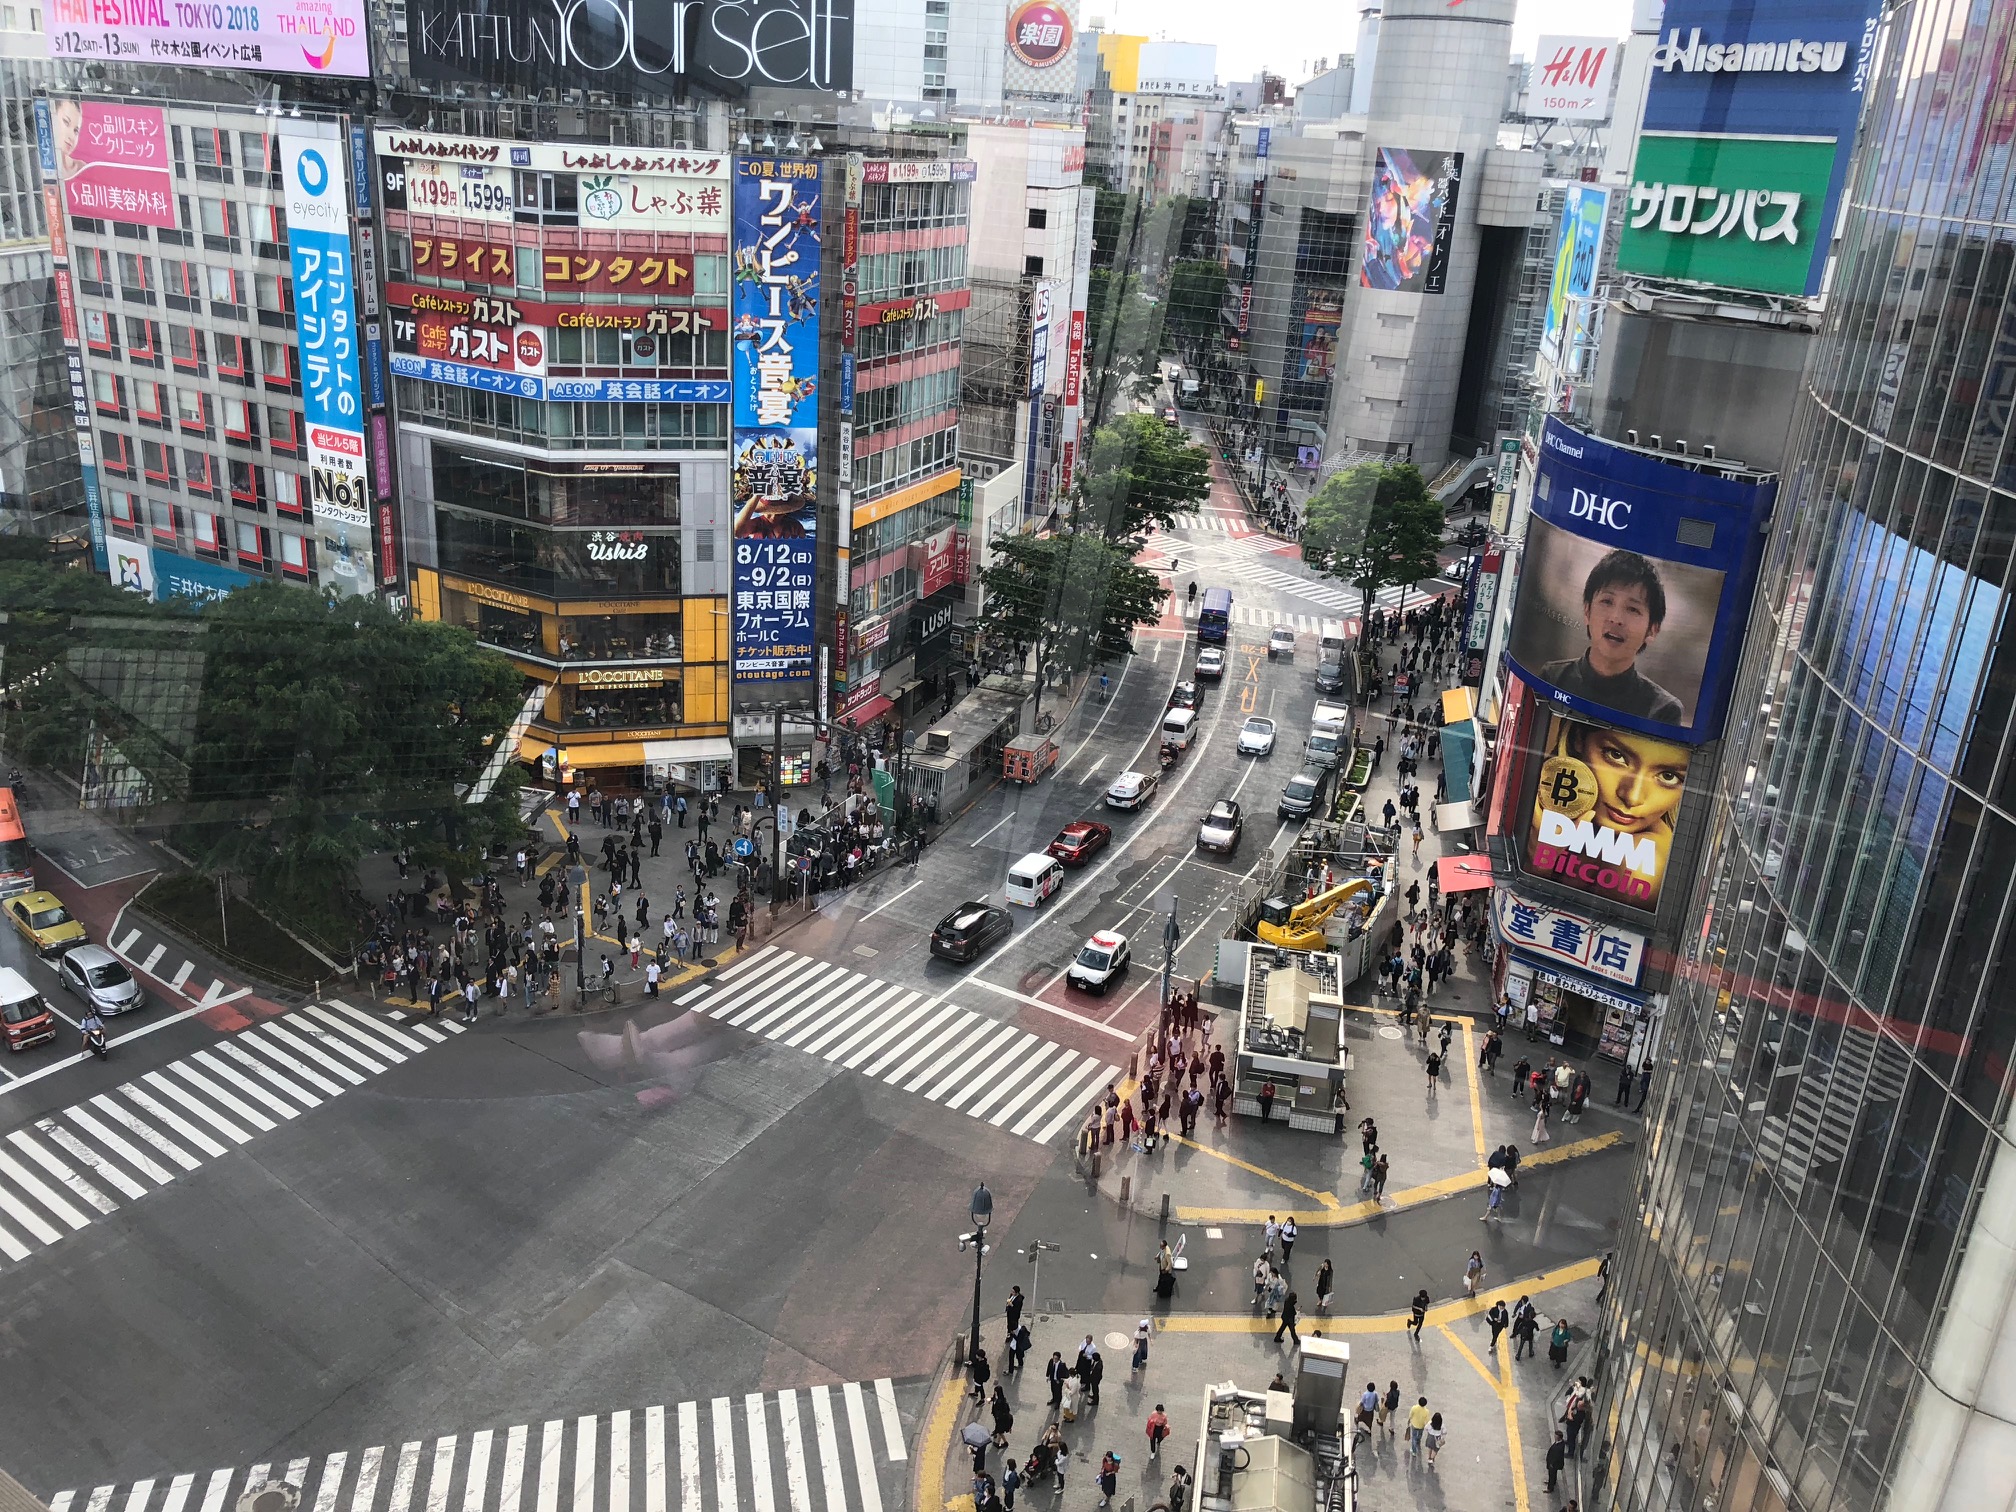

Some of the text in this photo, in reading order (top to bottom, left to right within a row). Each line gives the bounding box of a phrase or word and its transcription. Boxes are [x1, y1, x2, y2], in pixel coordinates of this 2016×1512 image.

[53, 0, 259, 32] THAI FESTIVAL TOKYO 2018
[296, 0, 332, 14] amazing
[276, 14, 355, 36] THAILAND
[1019, 22, 1063, 47] 楽園
[150, 41, 262, 62] 代々木公園イベント広場
[1010, 42, 1068, 68] EXCITING AMUSEMENT
[1651, 27, 1848, 74] Hisamitsu
[1851, 18, 1877, 92] サロンパス
[1541, 46, 1608, 89] H&M
[1163, 81, 1213, 93] 井門ビル
[104, 115, 159, 137] 品川スキン
[105, 137, 155, 158] クリニック
[389, 136, 501, 162] しゃぶしゃぶバイキング
[512, 150, 528, 162] 寿司
[355, 138, 367, 203] 東急リバブル
[563, 151, 720, 175] しゃぶしゃぶバイキング
[739, 162, 818, 179] この夏、世界初
[386, 172, 404, 191] 9F
[1438, 157, 1459, 218] 和楽器バンド
[81, 183, 168, 216] 品川美容外科
[632, 185, 722, 217] しゃぶ葉
[294, 202, 339, 223] eyecity
[1630, 181, 1801, 246] サロンパス
[414, 239, 688, 286] プライス コンタクト
[364, 248, 375, 304] 献血ルーム
[473, 297, 521, 327] ガスト
[757, 179, 799, 427] ワンピース音宴
[914, 299, 940, 322] ガスト
[297, 247, 355, 416] コンタクトの アイシティ
[395, 320, 416, 342] 7F
[421, 324, 447, 341] Café
[646, 310, 711, 335] ガスト
[845, 310, 853, 338] ガスト
[422, 340, 447, 351] レストラン
[450, 325, 509, 362] ガスト
[520, 347, 541, 357] ガスト
[394, 358, 536, 393] AEON 英会話イーオン 6F
[555, 383, 728, 400] AEON 英会話イーオン
[317, 432, 358, 453] 当ビル5階
[842, 427, 850, 477] 渋谷駅前ビル
[1545, 431, 1556, 447] DHC
[1555, 437, 1584, 459] Channel
[320, 454, 353, 470] 利用者数
[311, 466, 367, 513] No.1
[314, 504, 368, 524] コンタクトショップ
[1569, 488, 1632, 530] DHC
[592, 532, 616, 542] 渋谷
[586, 542, 648, 560] Ushi8
[930, 555, 949, 576] アコム
[467, 583, 530, 607] L'OCCITANE
[737, 590, 810, 610] 東京国際
[737, 611, 809, 629] フォーラム
[921, 605, 951, 638] LUSH
[737, 630, 779, 642] ホールC
[737, 644, 812, 657] チケット販売中!
[578, 670, 664, 684] L'OCCITANE
[736, 669, 811, 680] otoutage.com
[847, 683, 873, 707] サンドラッグ
[1554, 690, 1572, 704] DHC
[1538, 809, 1656, 876] DMM
[1533, 843, 1651, 899] Bitcoin
[1591, 965, 1633, 984] BOOKS TAISEIDO
